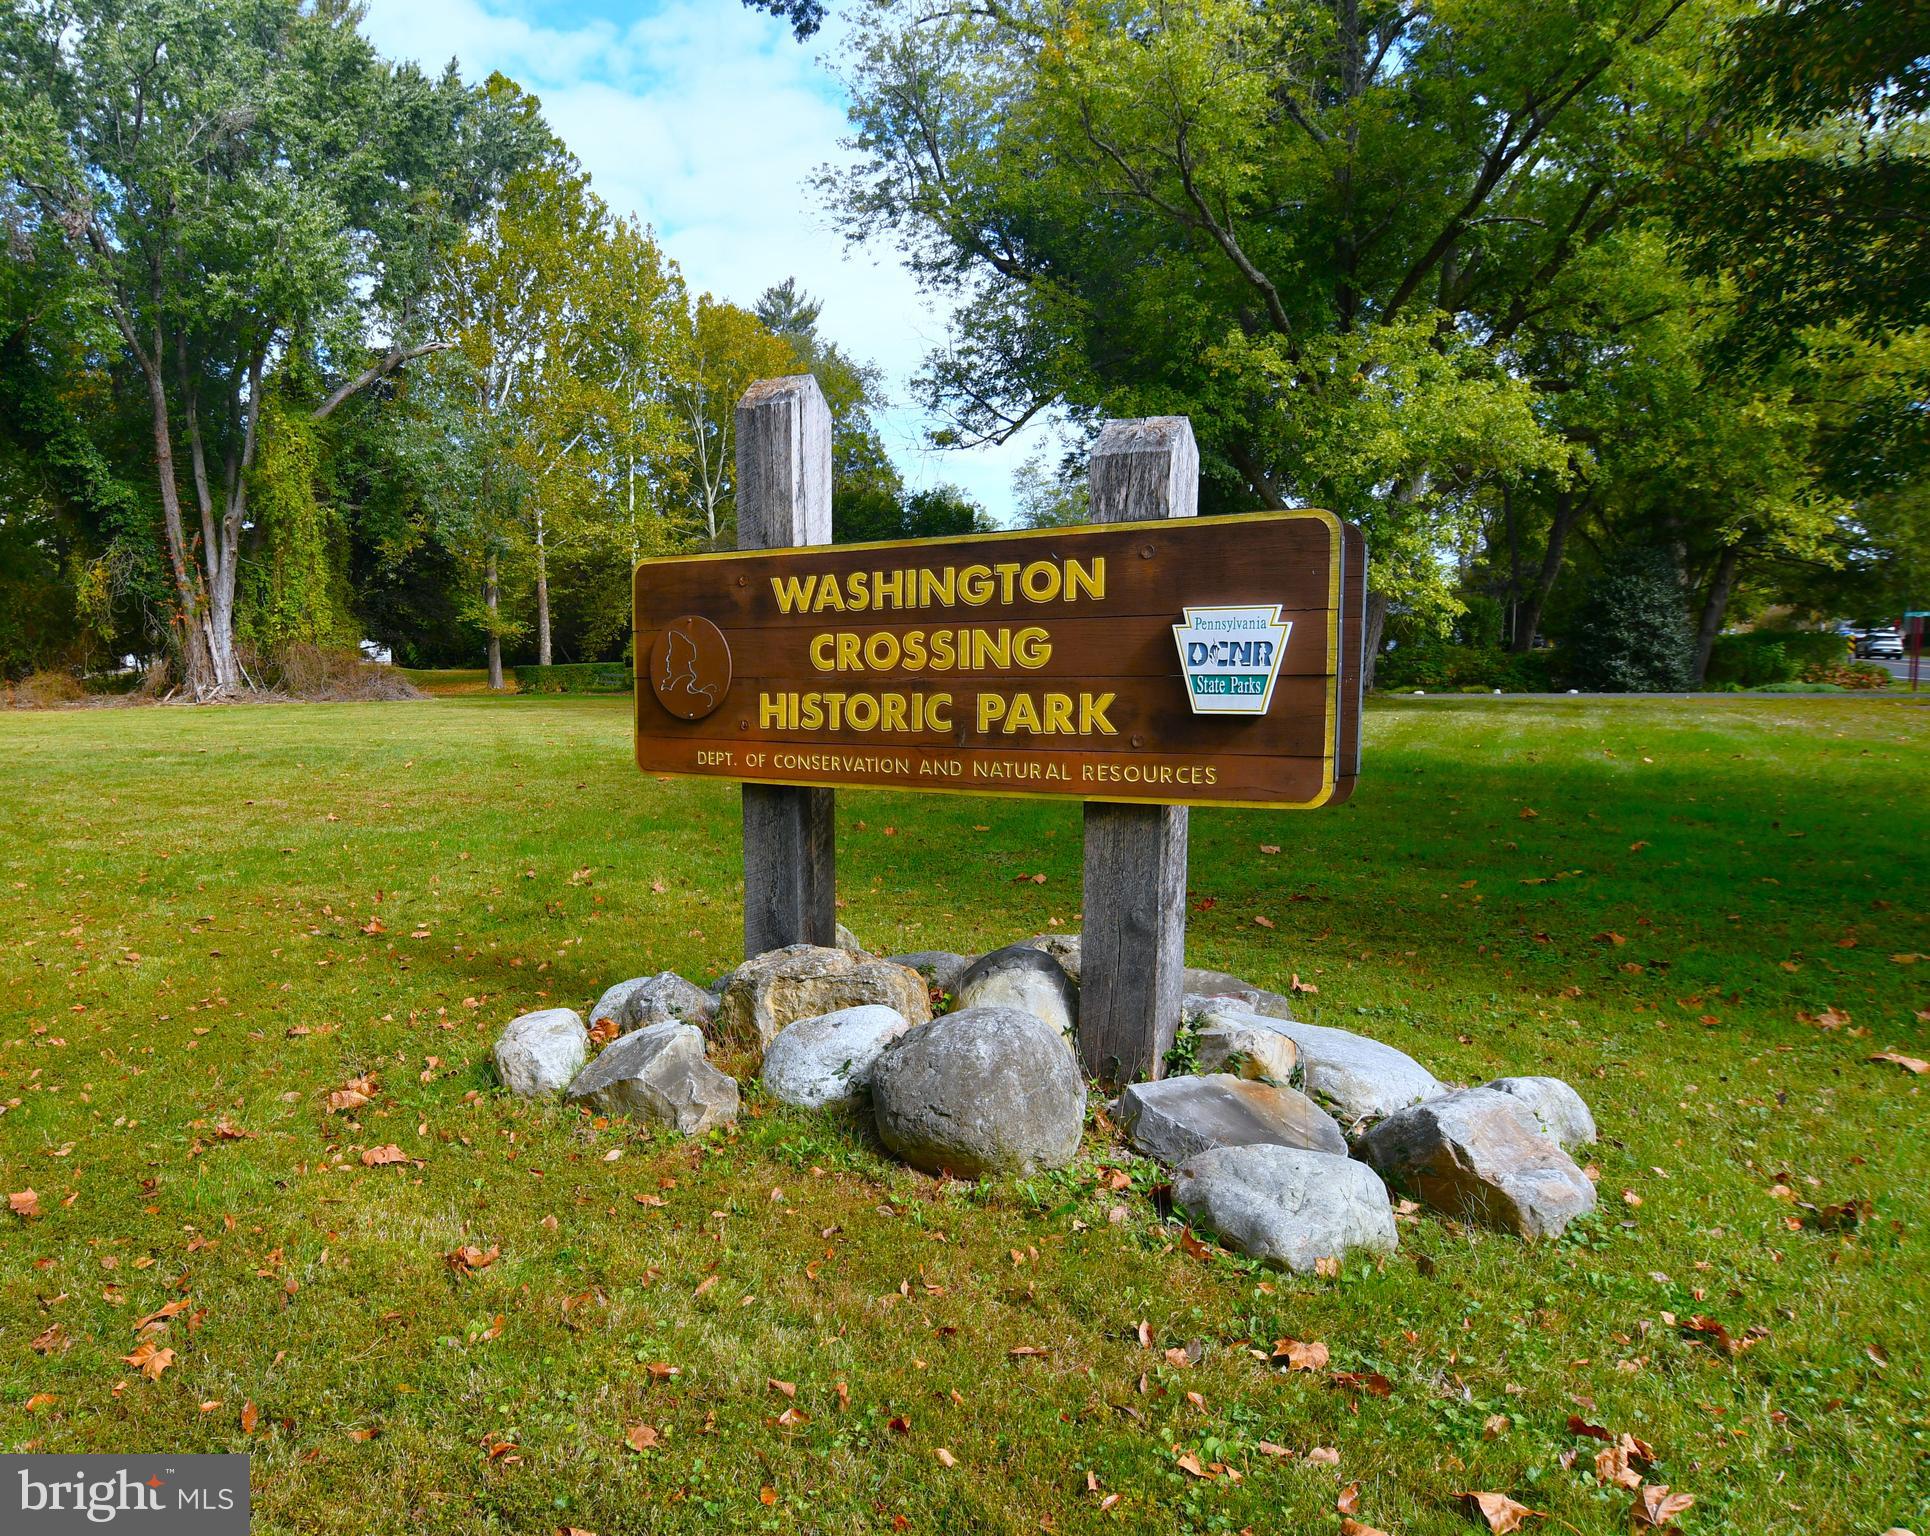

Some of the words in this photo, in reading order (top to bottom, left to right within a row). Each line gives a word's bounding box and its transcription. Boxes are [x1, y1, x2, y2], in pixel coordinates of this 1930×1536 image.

[770, 557, 1106, 614] WASHINGTON
[1194, 616, 1267, 632] Pennsylvania
[809, 627, 1053, 672] CROSSING
[1187, 640, 1274, 667] DCNR
[1196, 675, 1226, 694] State
[1230, 676, 1261, 694] Parks
[759, 692, 953, 732] HISTORIC
[976, 692, 1119, 736] PARK
[697, 750, 737, 767] DEPT.
[746, 752, 766, 768] OF
[773, 753, 909, 775] CONSERVATION
[919, 759, 962, 777] AND
[973, 760, 1072, 781] NATURAL
[1081, 764, 1218, 785] RESOURCES
